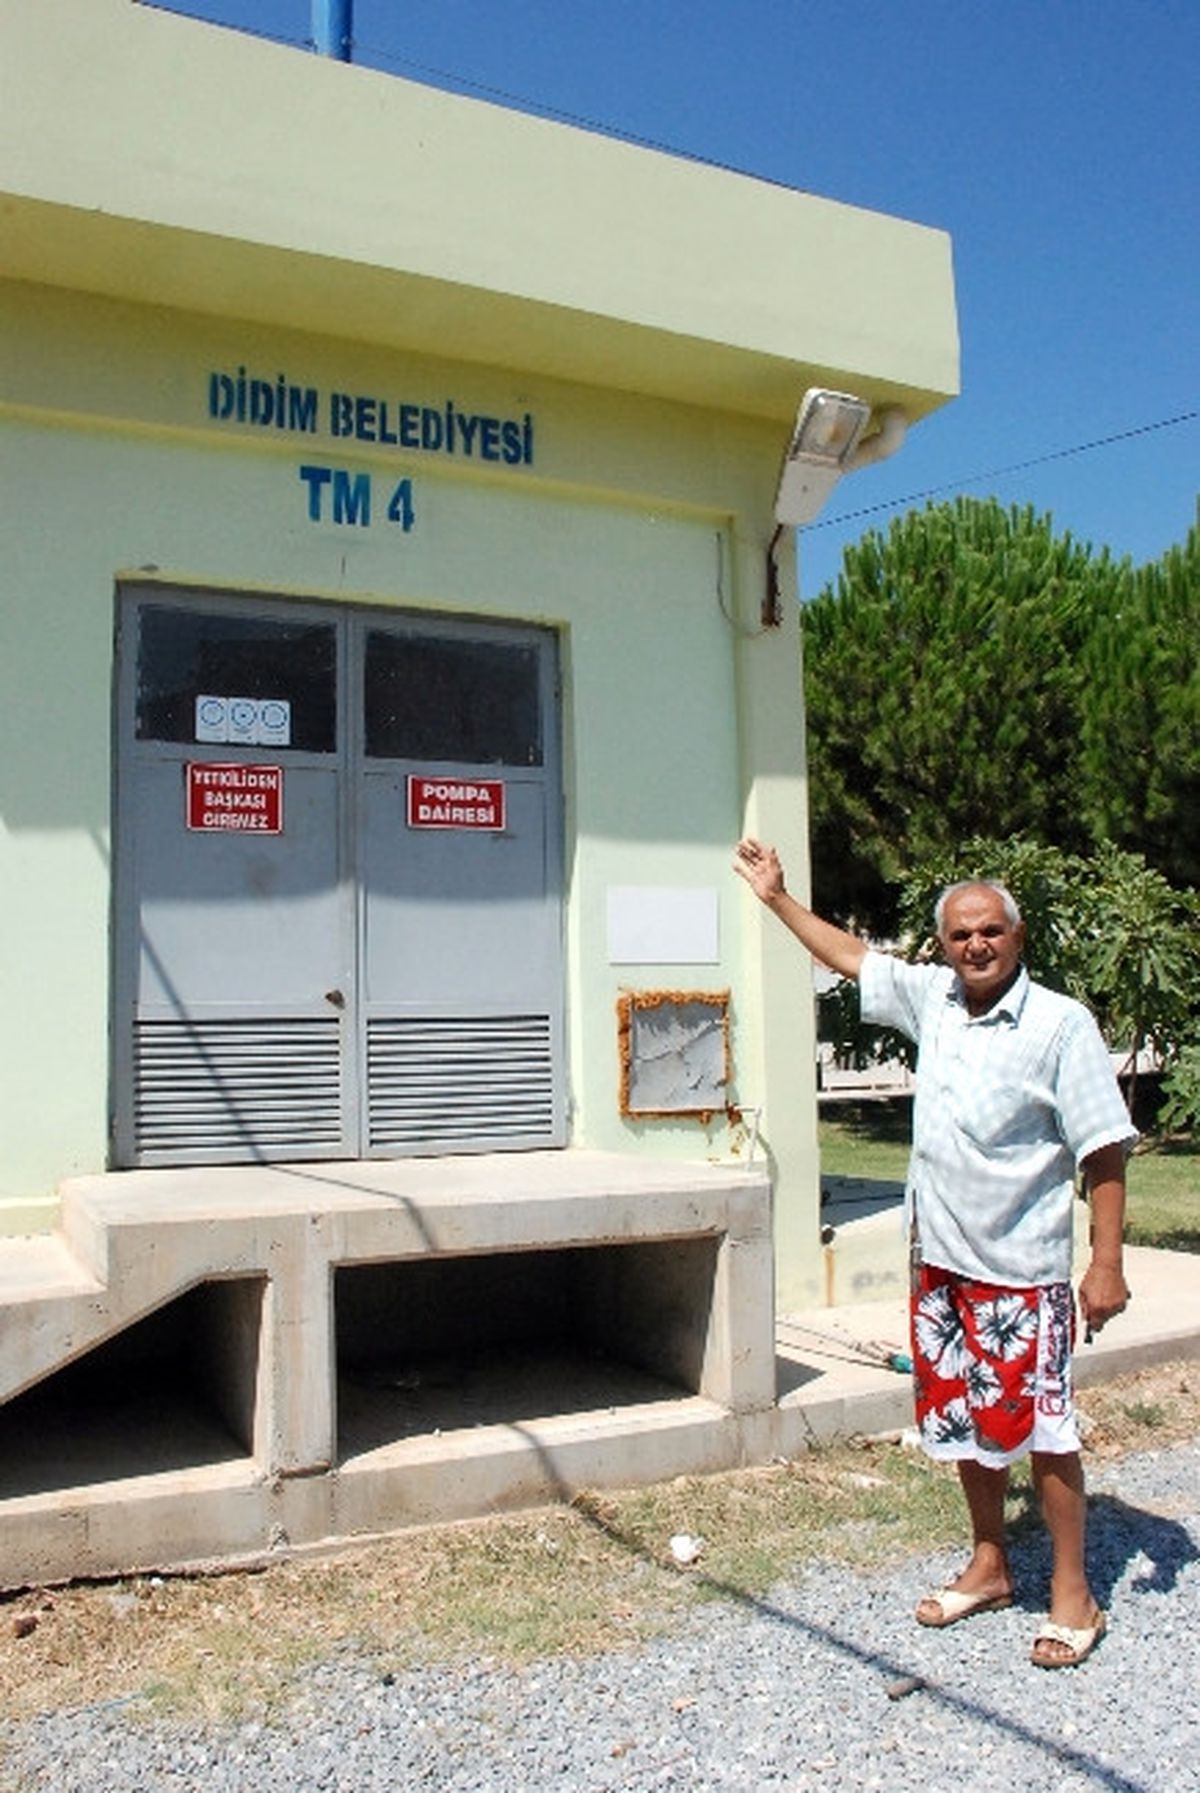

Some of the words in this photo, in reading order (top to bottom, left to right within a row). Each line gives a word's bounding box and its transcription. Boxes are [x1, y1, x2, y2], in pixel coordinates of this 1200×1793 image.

[208, 366, 319, 434] DİDİM
[330, 393, 535, 466] BELEDİYESİ
[299, 465, 371, 528] TM
[387, 479, 416, 533] 4
[203, 790, 267, 811] BAŞKASI
[422, 783, 492, 802] POMPA
[418, 802, 496, 823] DAİRESİ
